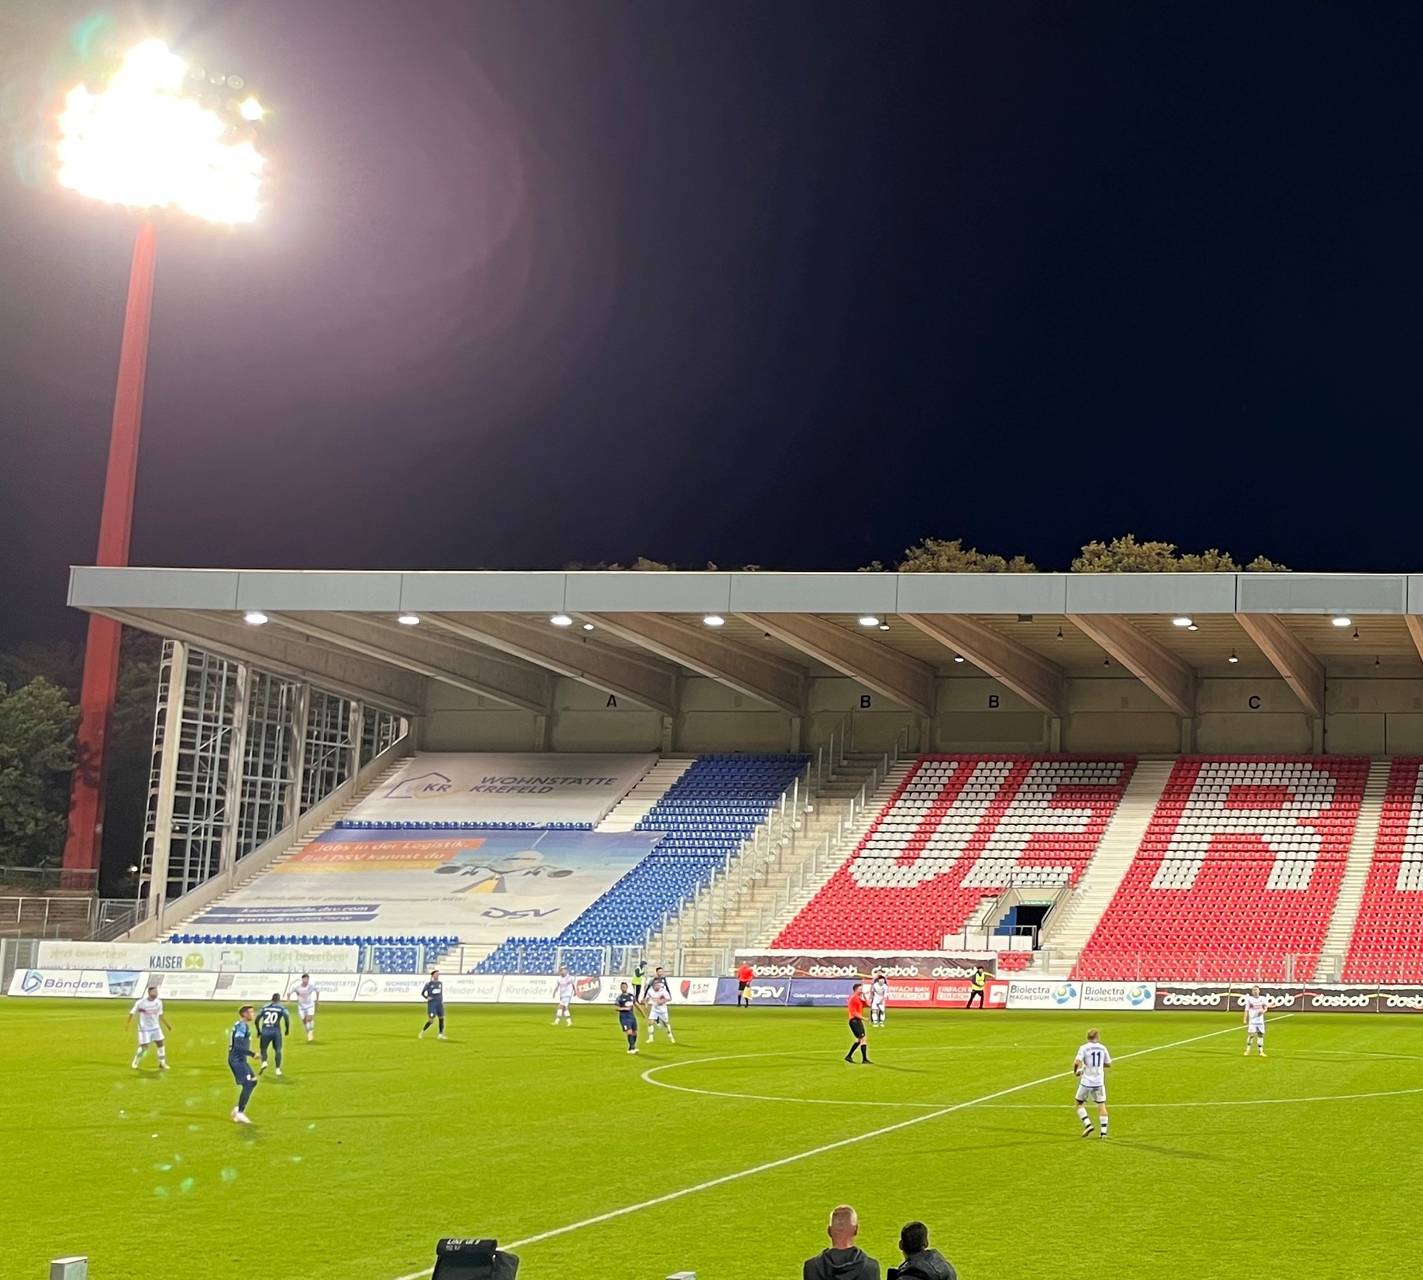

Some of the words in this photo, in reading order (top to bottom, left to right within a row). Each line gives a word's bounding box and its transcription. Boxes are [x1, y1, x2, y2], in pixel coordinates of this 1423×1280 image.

[606, 694, 618, 708] A
[860, 694, 872, 709] B
[988, 695, 1000, 709] B
[1248, 695, 1261, 710] C
[469, 784, 555, 794] KREFELD
[149, 955, 183, 969] KAISER
[44, 976, 104, 989] Bönders
[1010, 984, 1051, 994] Biolectra
[751, 986, 785, 998] DSV
[1085, 985, 1126, 995] Biolectra
[263, 1011, 279, 1024] 20
[1090, 1051, 1102, 1067] 11
